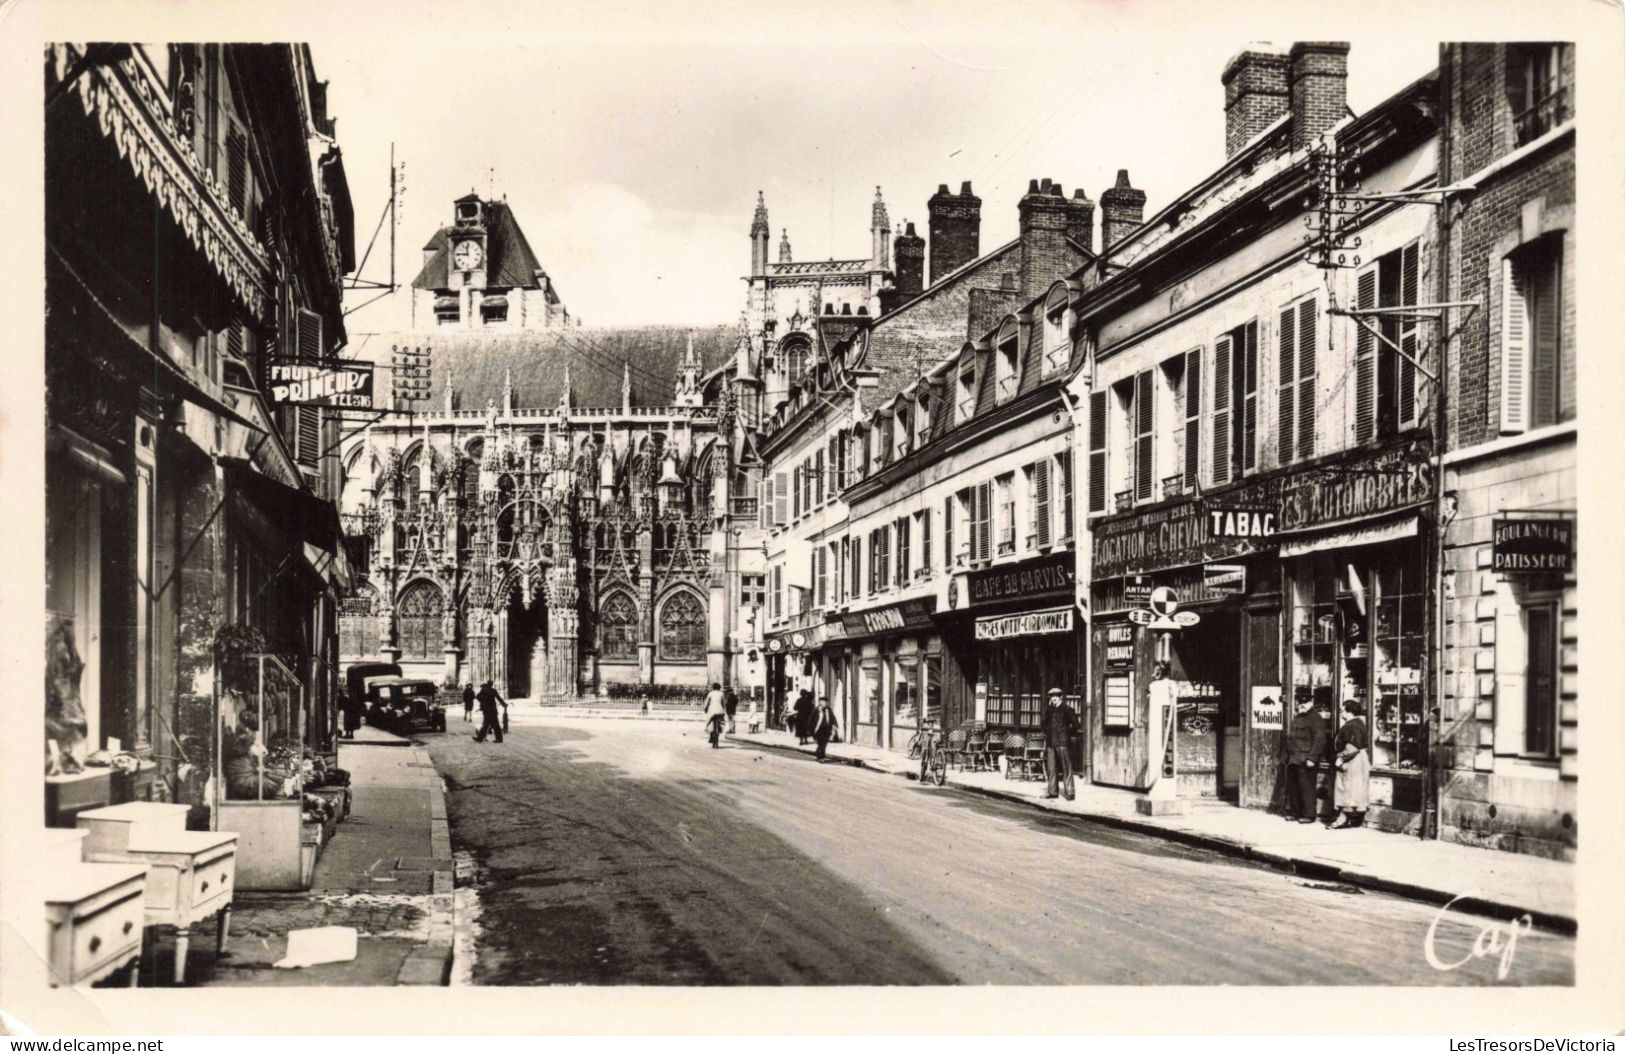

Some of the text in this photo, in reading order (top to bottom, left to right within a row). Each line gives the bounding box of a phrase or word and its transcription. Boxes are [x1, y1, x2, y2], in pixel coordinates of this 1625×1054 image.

[271, 371, 370, 402] PRIMEURS
[1311, 462, 1430, 521] AUTOMOBILES
[1211, 511, 1275, 537] TABAC
[1495, 523, 1568, 546] BOULANGERIE
[1093, 530, 1146, 567] LOCATION
[1495, 553, 1567, 568] PATISSERIE
[1020, 564, 1067, 592] PARVIS
[1125, 585, 1151, 594] ANTAR
[1107, 645, 1134, 660] RENAULT
[1253, 710, 1283, 725] Mobiloil
